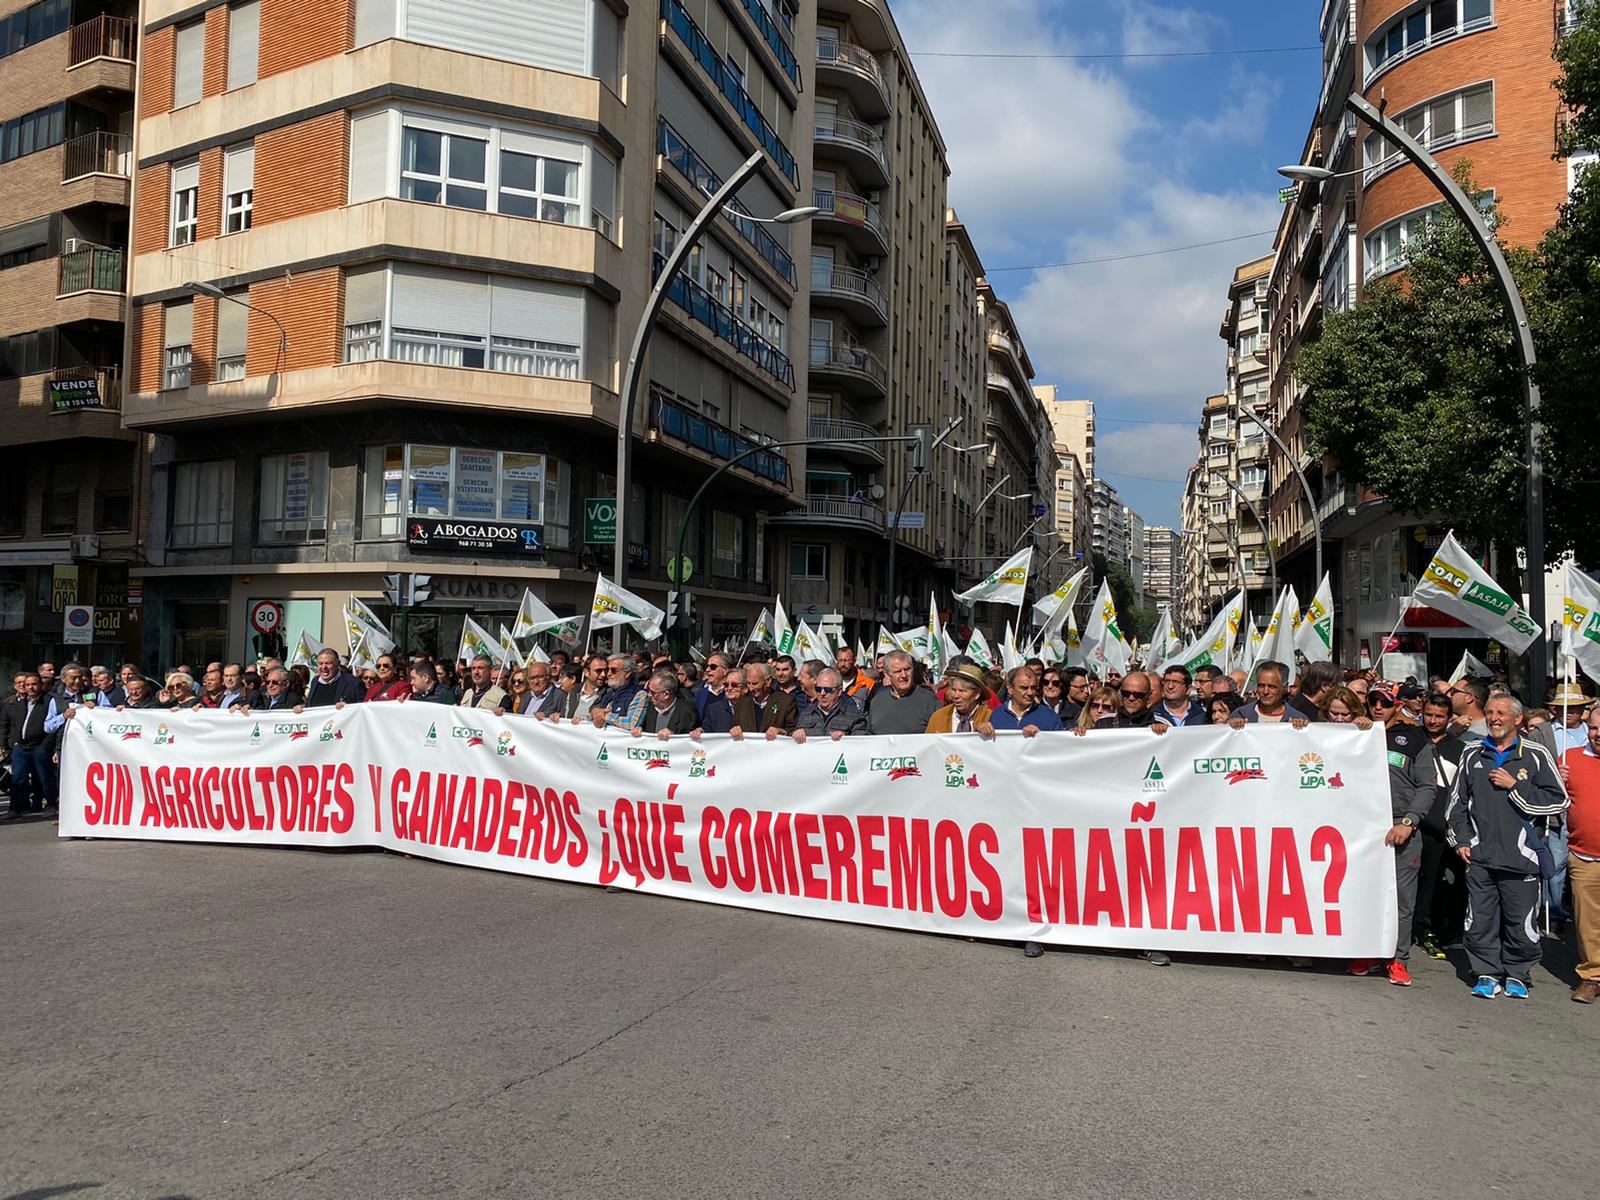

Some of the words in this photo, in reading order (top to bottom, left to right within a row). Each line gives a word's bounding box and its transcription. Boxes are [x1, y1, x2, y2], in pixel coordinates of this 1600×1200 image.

[52, 380, 96, 390] VENDE
[462, 456, 490, 464] DERECHO
[460, 464, 492, 473] SANITARIO
[457, 486, 493, 494] ESTATUTARIO
[433, 524, 517, 539] ABOGADOS
[1429, 562, 1464, 588] COAG
[54, 578, 77, 590] COMPRO
[54, 591, 76, 611] ORO
[93, 611, 120, 629] Gold
[258, 611, 274, 622] 30
[1507, 617, 1535, 637] UPA
[628, 749, 670, 760] COAG
[871, 757, 917, 770] COAG
[1195, 758, 1261, 773] COAG
[946, 775, 965, 787] UPA
[1300, 775, 1326, 788] UPA
[85, 762, 133, 826] SIN
[141, 763, 355, 834] AGRICULTORES
[368, 767, 383, 832] Y
[392, 768, 588, 868] GANADEROS
[599, 784, 691, 891] ¿QUÉ
[700, 806, 1003, 921] COMEREMOS
[1023, 802, 1347, 936] MAÑANA?
